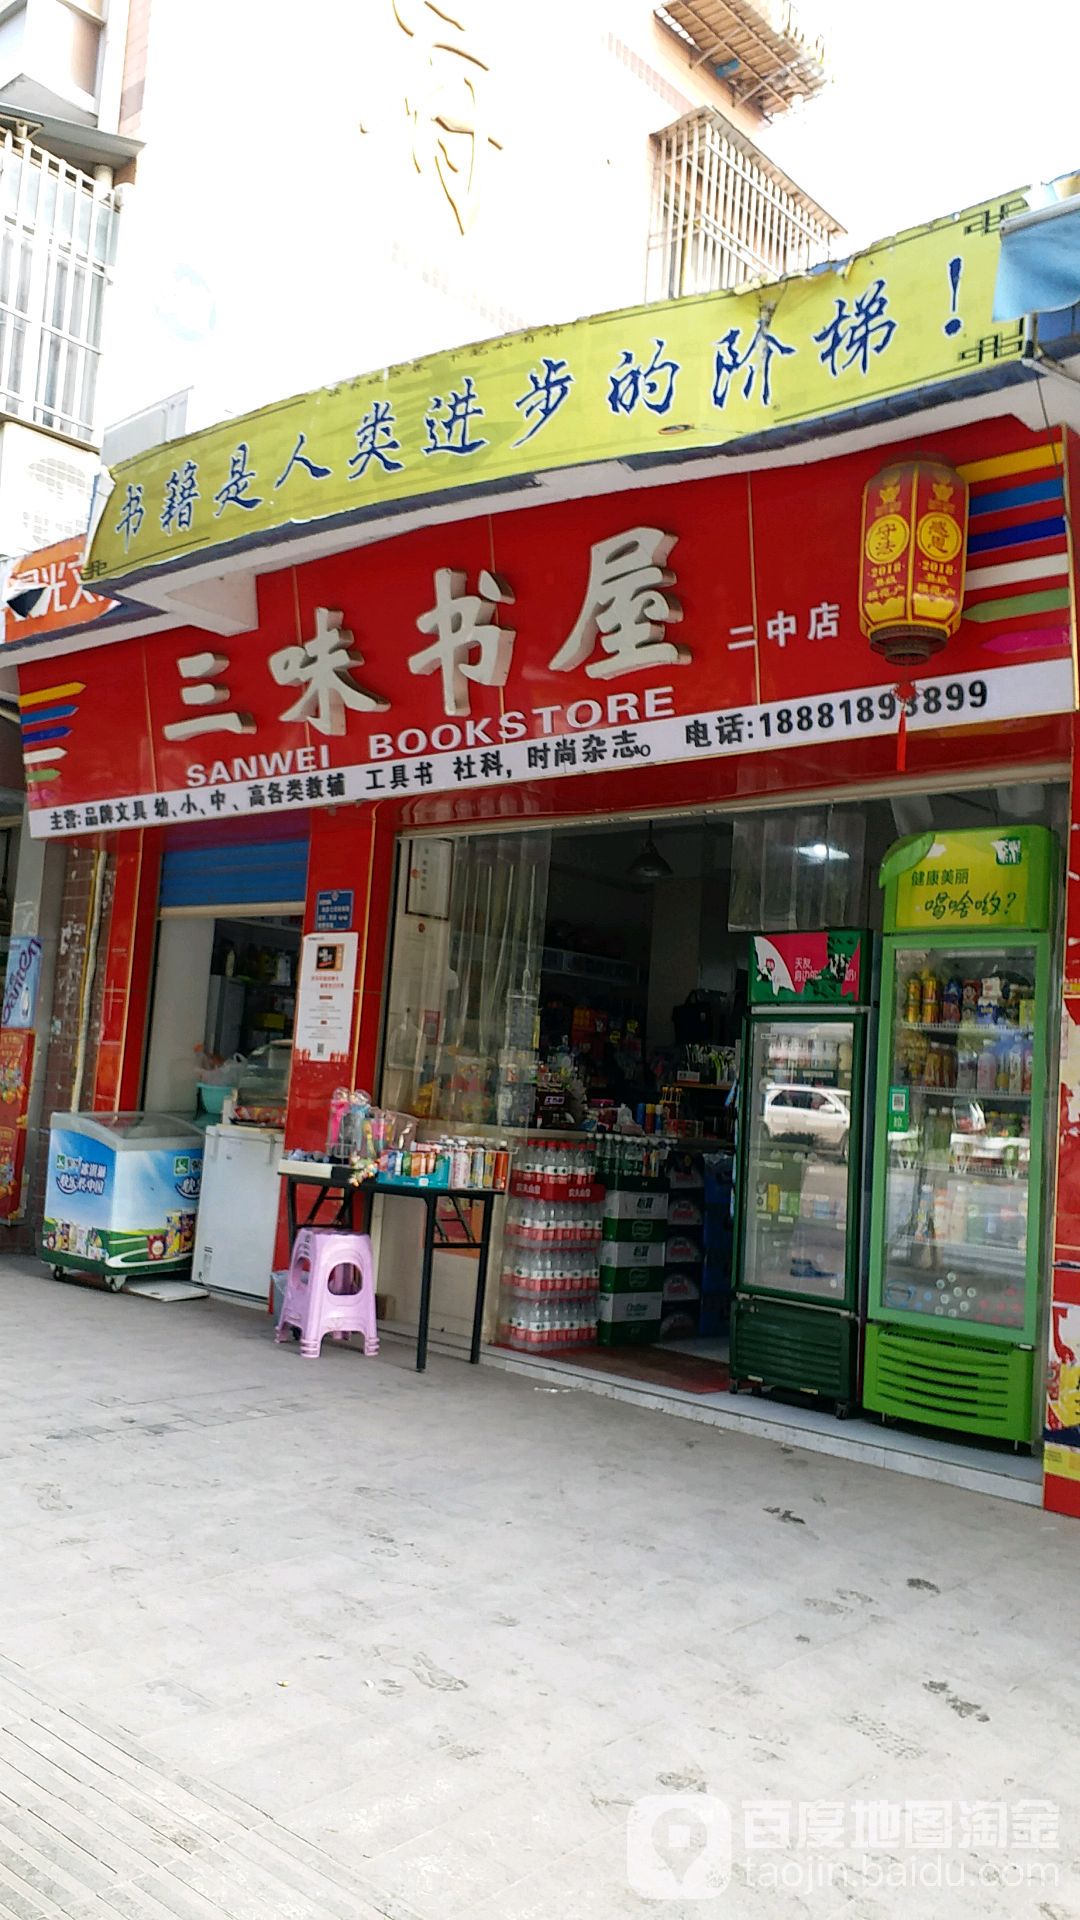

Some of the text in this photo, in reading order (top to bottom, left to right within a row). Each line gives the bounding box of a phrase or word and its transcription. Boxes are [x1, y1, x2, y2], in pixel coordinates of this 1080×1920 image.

[870, 560, 901, 578] 2018
[921, 559, 953, 576] 2018
[162, 526, 692, 741] 三味书屋
[727, 602, 840, 650] 二中店
[186, 686, 676, 789] SANWEI BOOKSTORE
[365, 760, 434, 791] 工具书
[911, 868, 969, 886] 健康美丽
